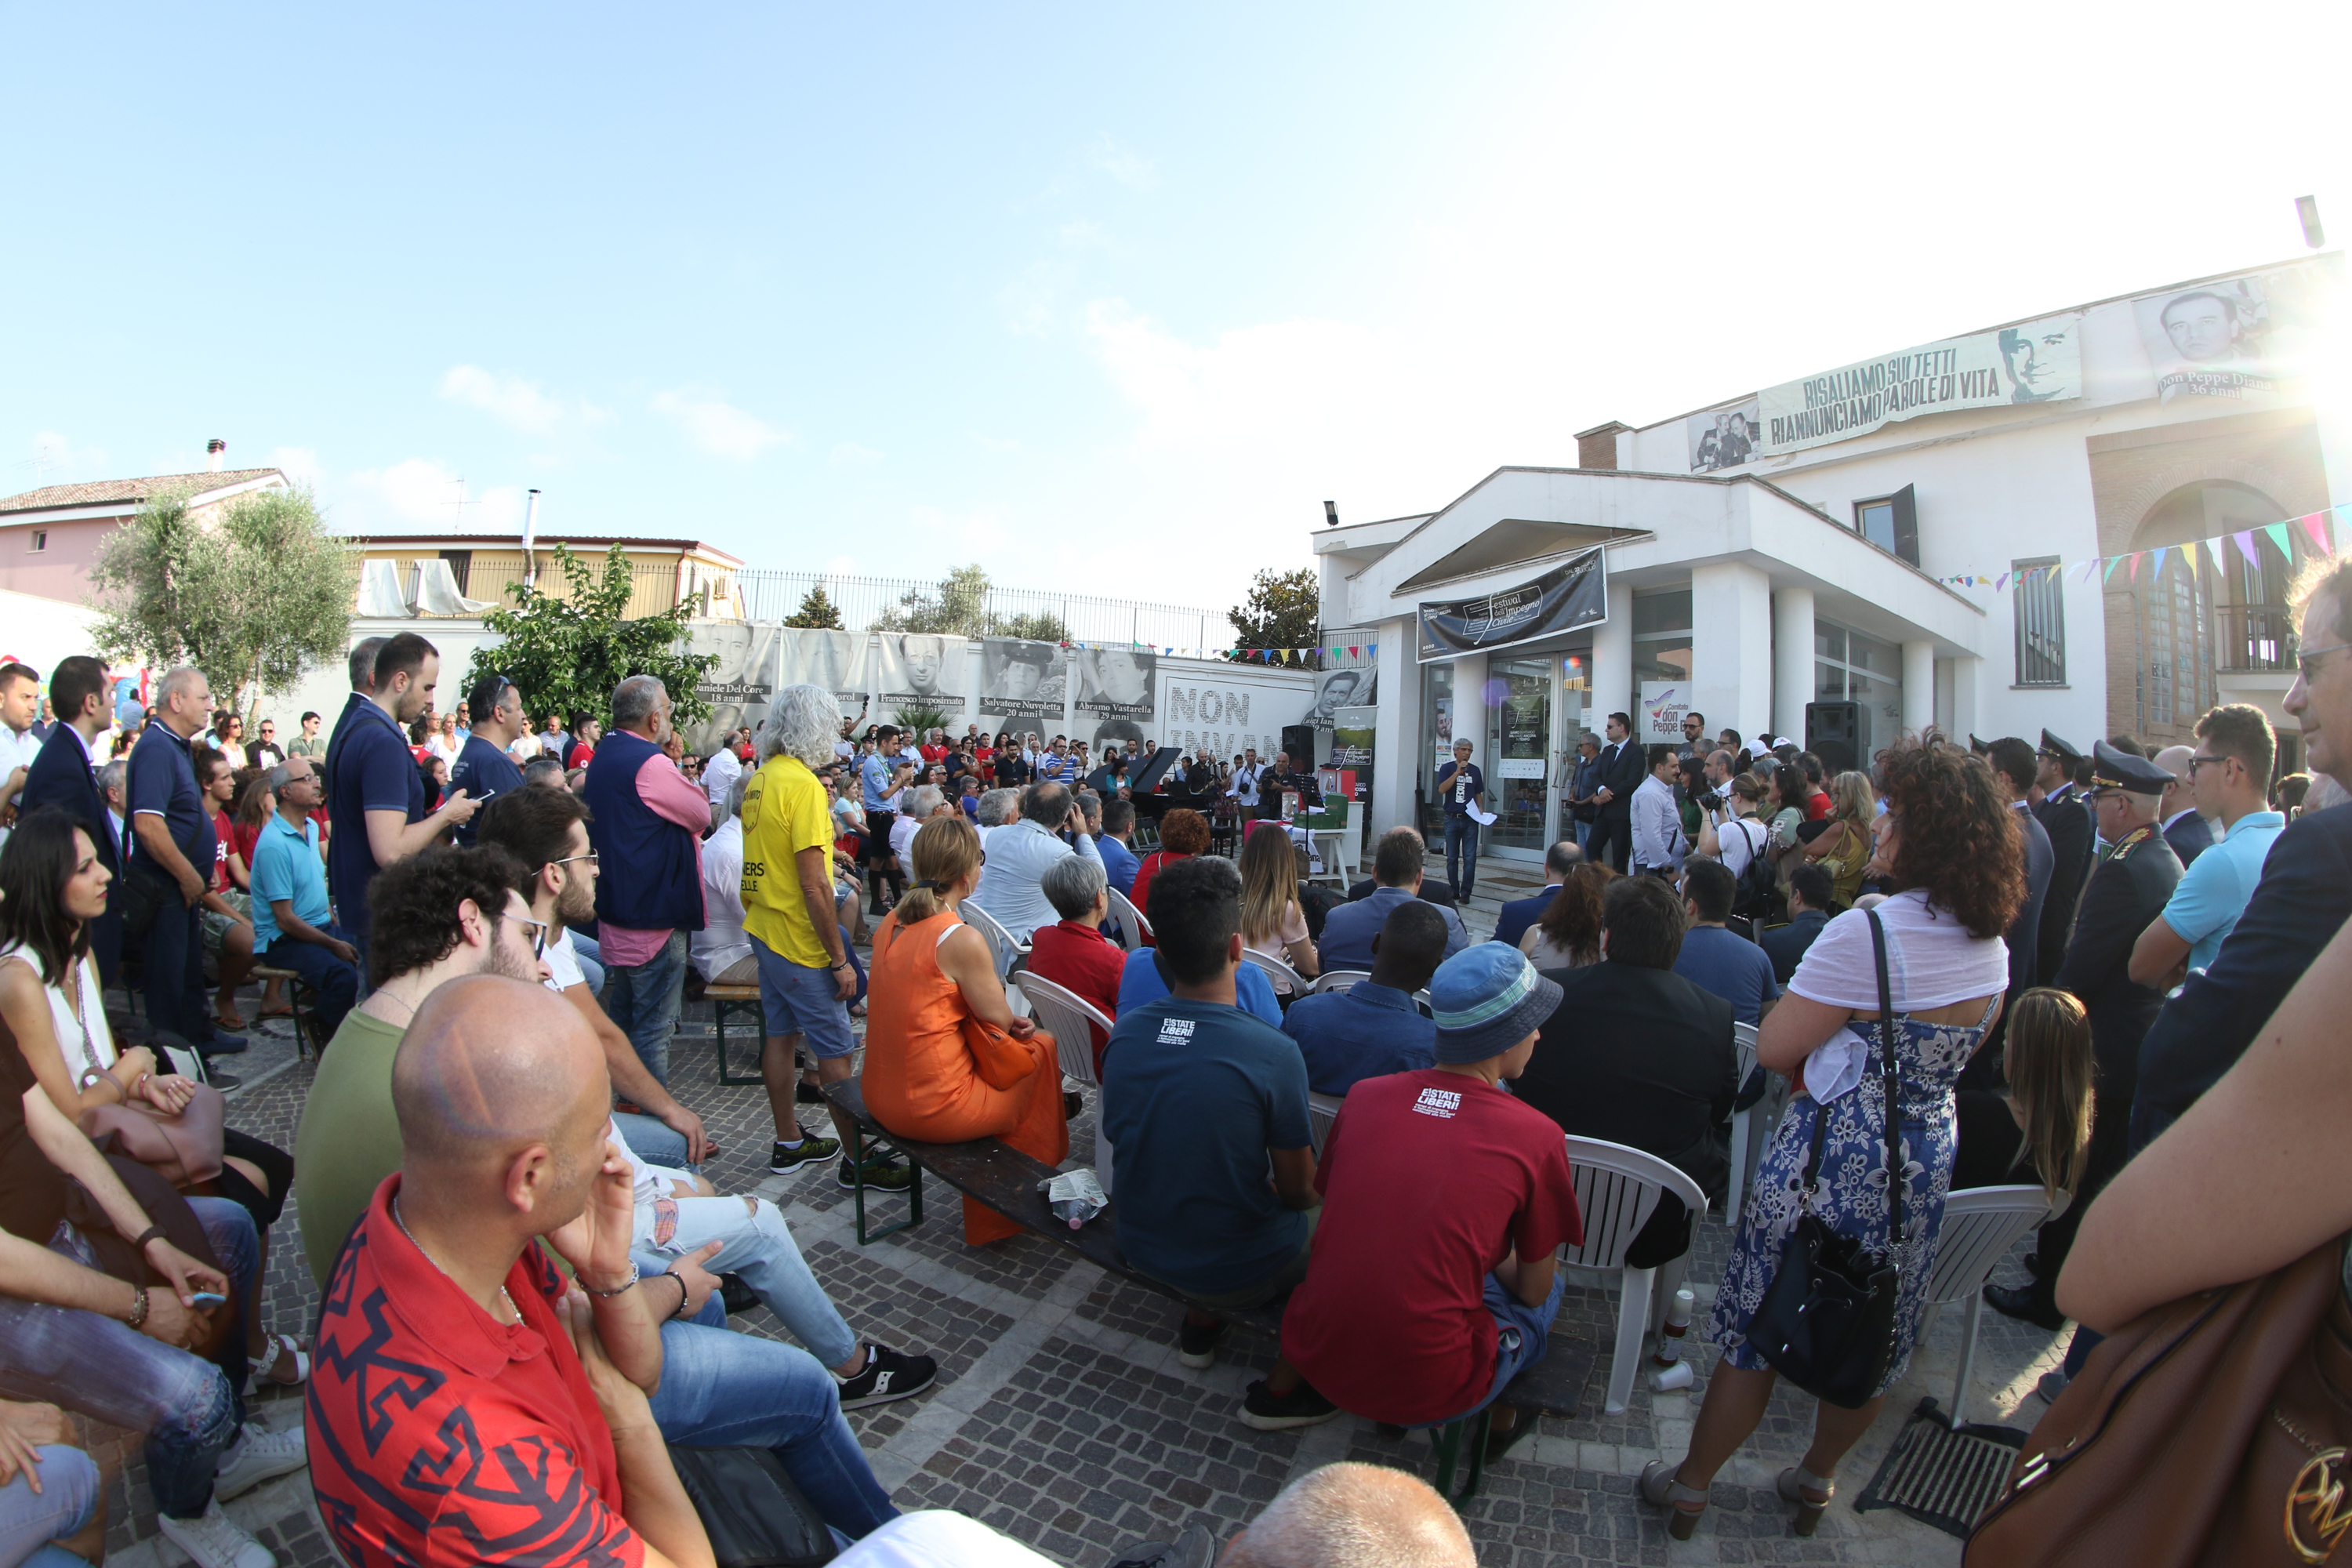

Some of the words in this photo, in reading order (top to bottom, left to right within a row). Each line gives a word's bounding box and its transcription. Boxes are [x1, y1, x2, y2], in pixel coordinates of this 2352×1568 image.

[1803, 363, 1886, 410] RISALIAMO
[1887, 355, 1911, 386] SUI
[1914, 348, 1957, 378] TETTI
[2158, 374, 2183, 392] Don
[2187, 372, 2229, 385] Peppe
[2232, 372, 2272, 390] Diana
[2190, 384, 2207, 394] 36
[2210, 387, 2241, 399] anni
[1770, 393, 1882, 445] RIANNUNCIAMO
[1882, 377, 1937, 416] PAROLE
[1939, 373, 1956, 401] DI
[1959, 368, 2000, 399] VITA
[1491, 614, 1514, 627] Civile
[726, 684, 740, 693] Del
[741, 684, 764, 694] Core
[711, 693, 722, 702] 18
[723, 694, 743, 702] anni
[880, 694, 917, 704] Francesco
[918, 695, 964, 706] Imposimato
[984, 698, 1021, 708] Salvatore
[1022, 700, 1061, 711] Nuvoletta
[1078, 702, 1110, 711] Abramo
[1112, 703, 1152, 713] Vastarella
[1171, 687, 1250, 727] NON
[1006, 708, 1017, 717] 20
[1018, 710, 1039, 718] anni
[1662, 708, 1678, 722] don
[1653, 720, 1678, 735] Peppe
[1171, 729, 1283, 766] INVAN
[741, 880, 758, 892] ELLE
[1163, 1018, 1196, 1029] E!STATE
[1160, 1025, 1194, 1036] LIBERI!
[1421, 1087, 1462, 1102] E!STATE
[1417, 1095, 1460, 1110] LIBERI!
